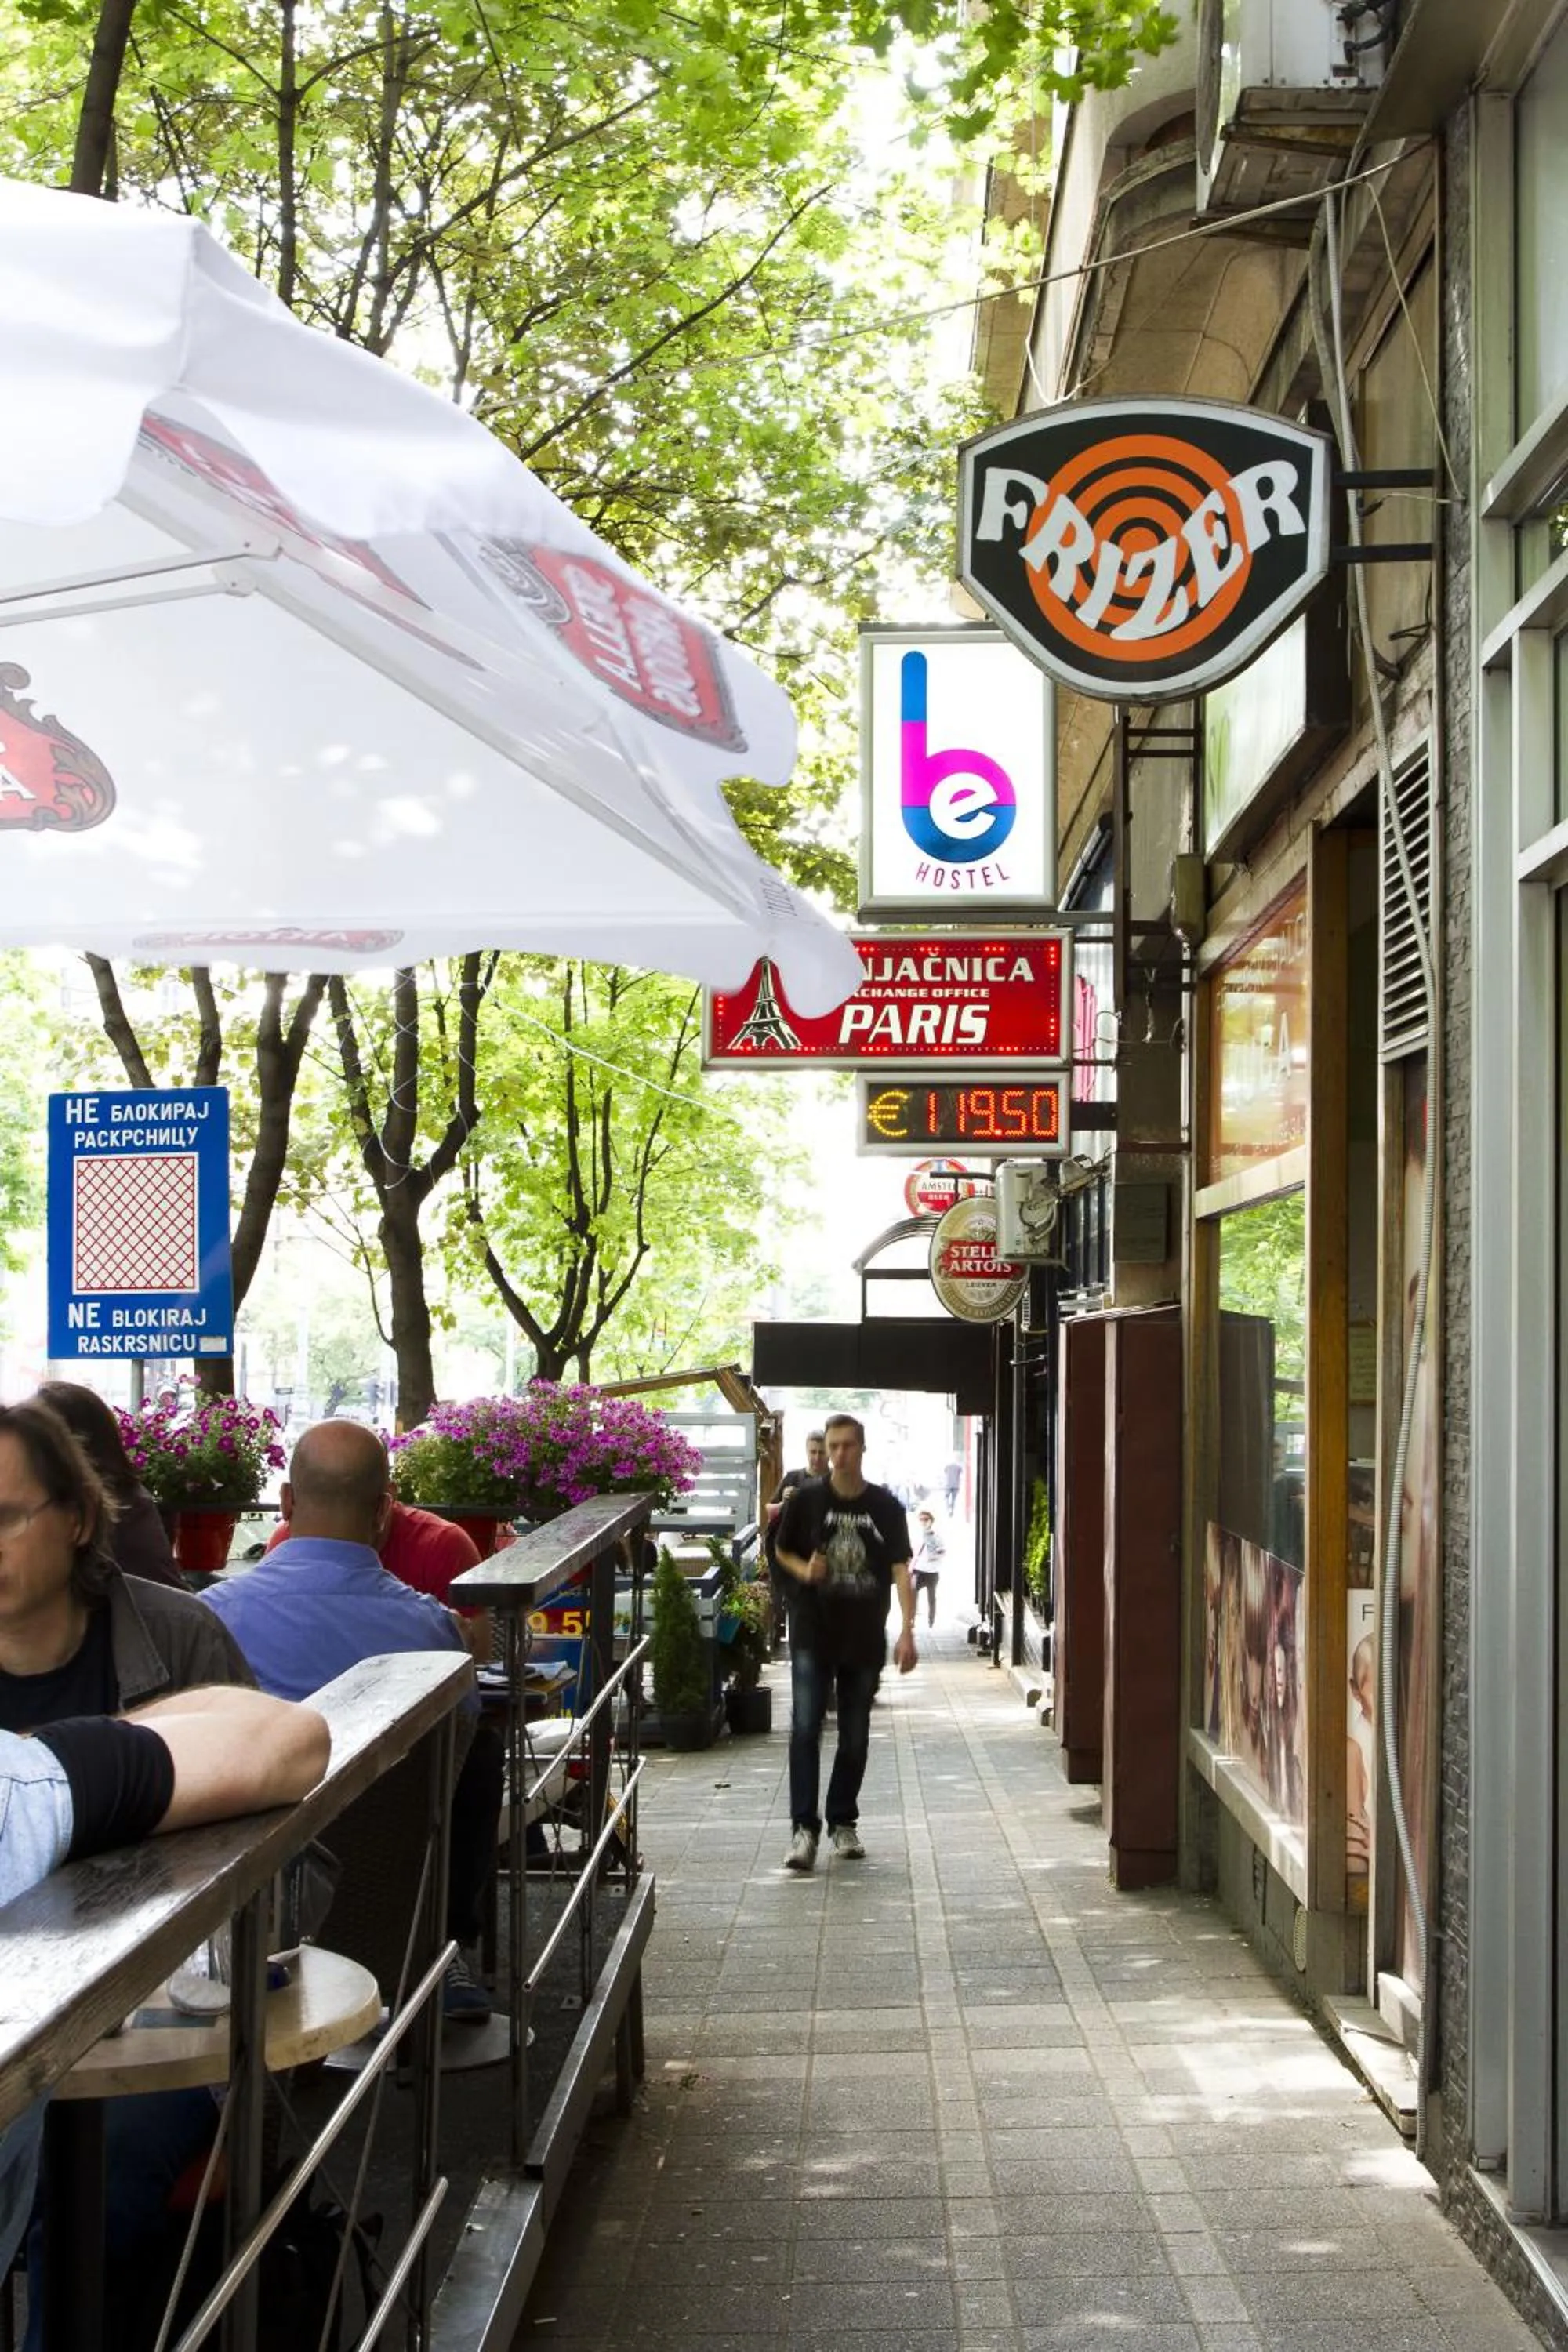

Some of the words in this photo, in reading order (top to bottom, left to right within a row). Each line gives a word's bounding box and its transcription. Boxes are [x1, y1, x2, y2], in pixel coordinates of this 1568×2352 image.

[976, 460, 1306, 641] FRIZER
[915, 862, 1010, 889] HOSTEL
[932, 988, 990, 998] OFFICE
[838, 1004, 991, 1044] PARIS
[65, 1098, 100, 1124] НЕ
[111, 1102, 209, 1122] БЛОКИРАЈ
[74, 1127, 199, 1149] РАСКРСНИЦУ
[921, 1181, 956, 1191] AMSTE
[950, 1246, 996, 1258] STELL
[949, 1260, 1012, 1272] ARTOIS
[68, 1302, 101, 1328] NE
[112, 1308, 206, 1328] BLOKIRAJ
[78, 1334, 196, 1353] RASKRSNICU
